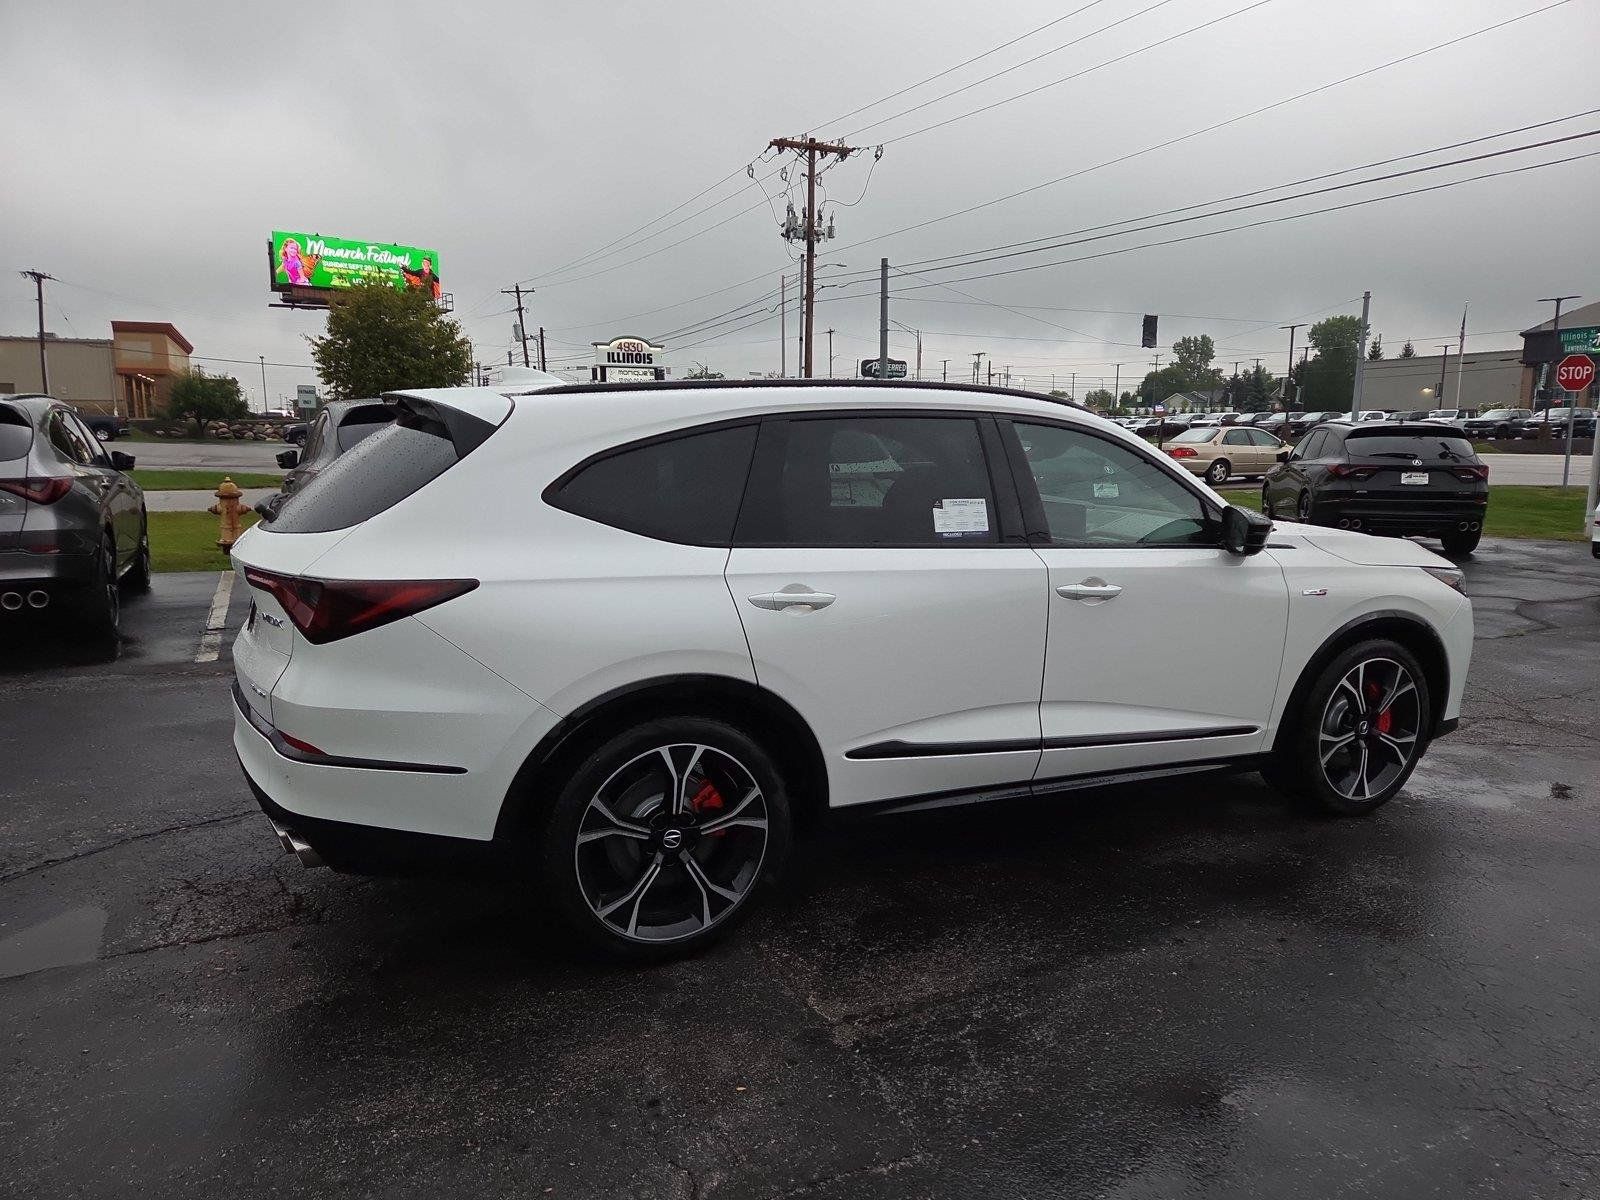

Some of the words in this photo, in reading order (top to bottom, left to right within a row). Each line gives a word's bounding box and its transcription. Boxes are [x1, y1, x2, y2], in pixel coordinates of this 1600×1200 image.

[306, 237, 366, 260] Monarch
[366, 245, 411, 267] Festival
[1561, 331, 1588, 341] Illinois
[616, 341, 643, 353] 4930
[607, 351, 653, 365] ILLINOIS
[866, 361, 907, 374] PRERRED
[1560, 366, 1592, 380] STOP
